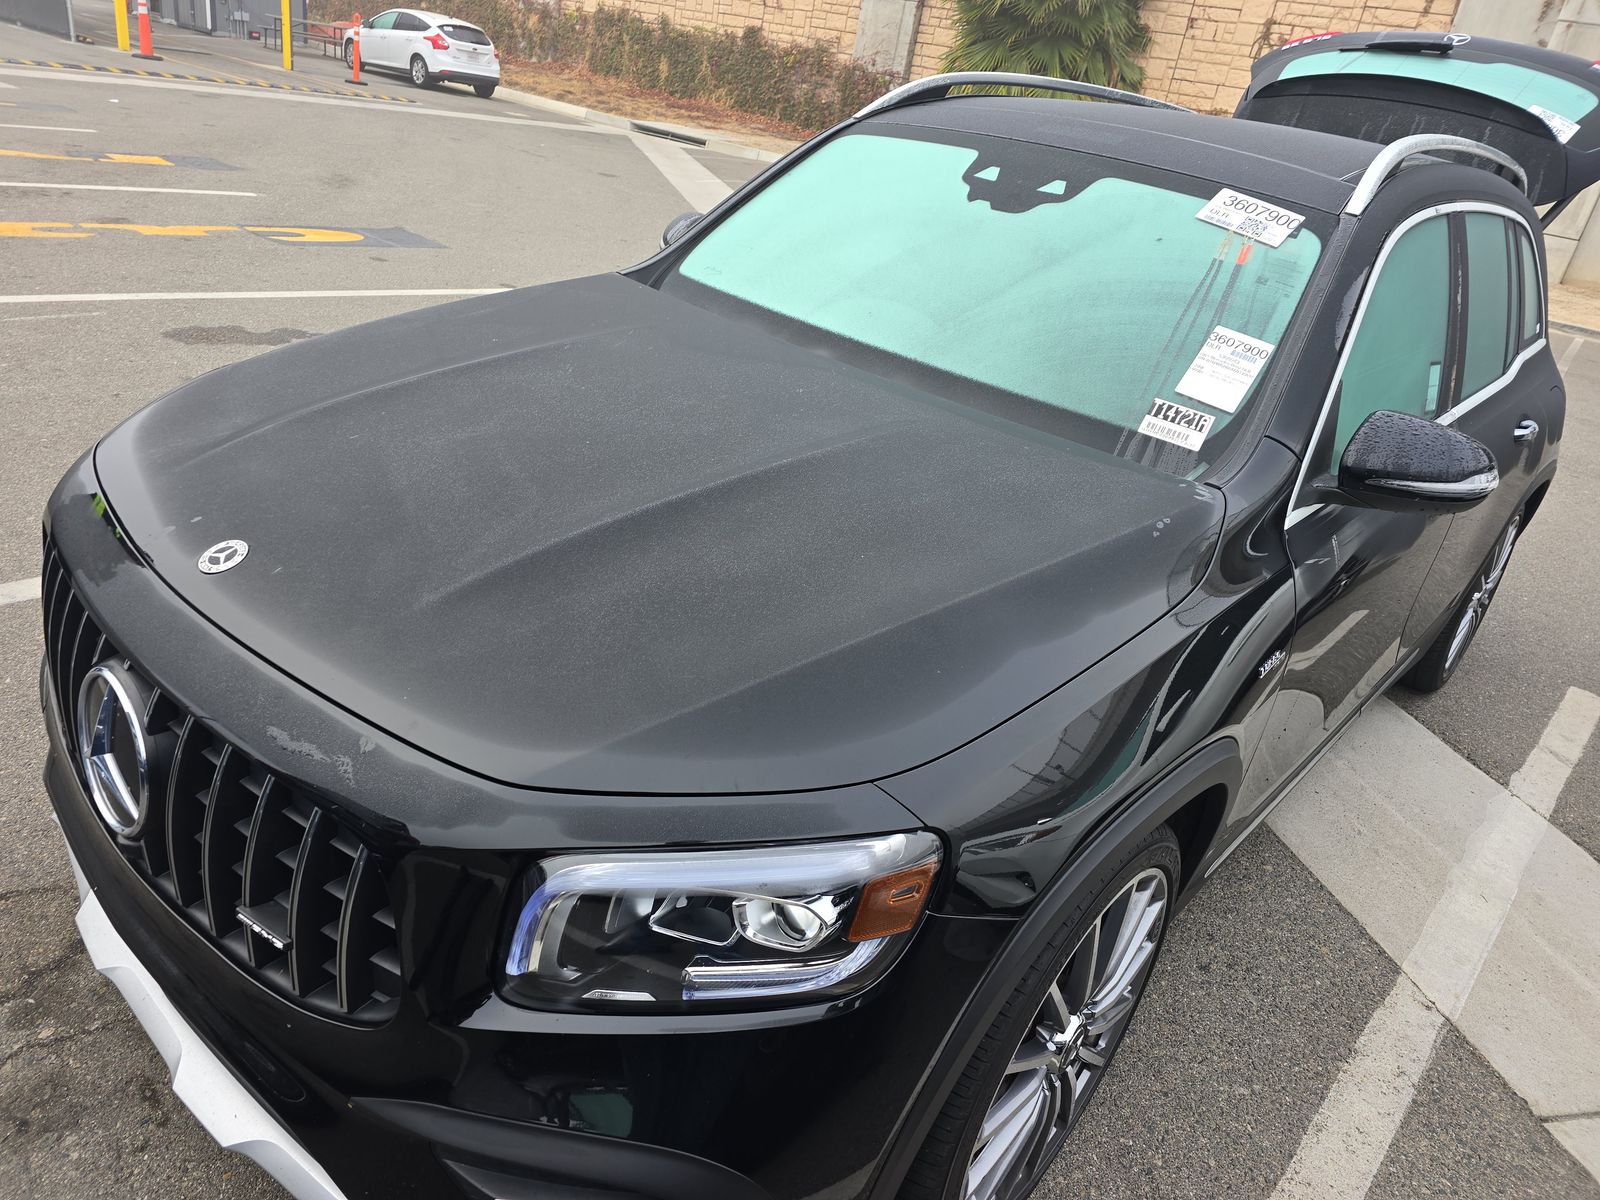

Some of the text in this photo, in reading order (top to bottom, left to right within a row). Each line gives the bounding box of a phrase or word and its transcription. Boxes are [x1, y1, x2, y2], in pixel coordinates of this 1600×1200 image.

[1223, 195, 1301, 230] 3607900
[1209, 331, 1269, 360] 3607900
[1151, 400, 1211, 433] T14721A
